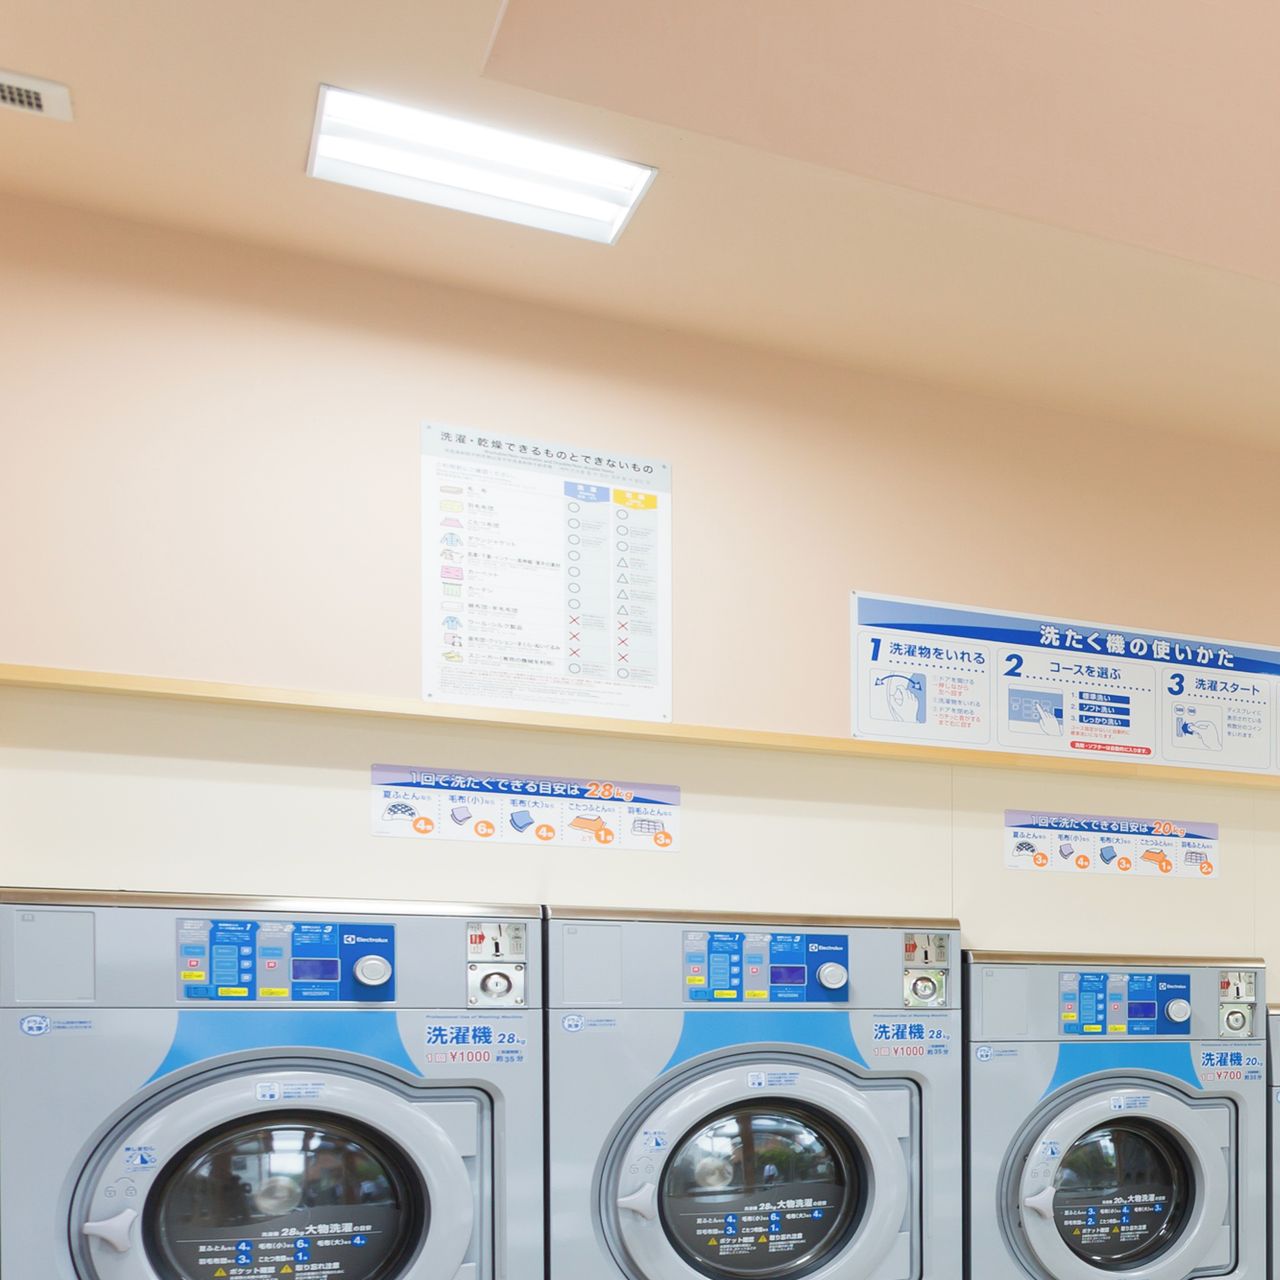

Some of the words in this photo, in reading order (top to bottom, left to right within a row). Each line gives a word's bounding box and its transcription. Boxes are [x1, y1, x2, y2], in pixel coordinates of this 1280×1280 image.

[440, 431, 654, 475] 洗濯・乾燥できるものとできないもの
[871, 638, 882, 661] 1
[889, 641, 986, 665] 洗濯物をいれる
[1040, 624, 1235, 668] 洗たく機の使いかた
[1003, 653, 1024, 678] 2
[1049, 661, 1121, 681] コースを選ぶ
[1168, 673, 1185, 696] 3
[1195, 677, 1260, 696] 洗濯スタート
[410, 771, 580, 797] 1回で洗たくできる目安は
[583, 781, 633, 802] 28kg
[1031, 815, 1149, 833] 1回で洗たくできる目安は
[1152, 821, 1186, 838] 20kg
[426, 1025, 493, 1045] 洗濯機
[497, 1033, 527, 1045] 28kg
[874, 1023, 925, 1040] 洗濯機
[450, 1051, 491, 1063] ¥1000
[893, 1046, 925, 1056] ¥1000
[1202, 1052, 1243, 1067] 洗濯機
[1216, 1070, 1242, 1081] ¥700
